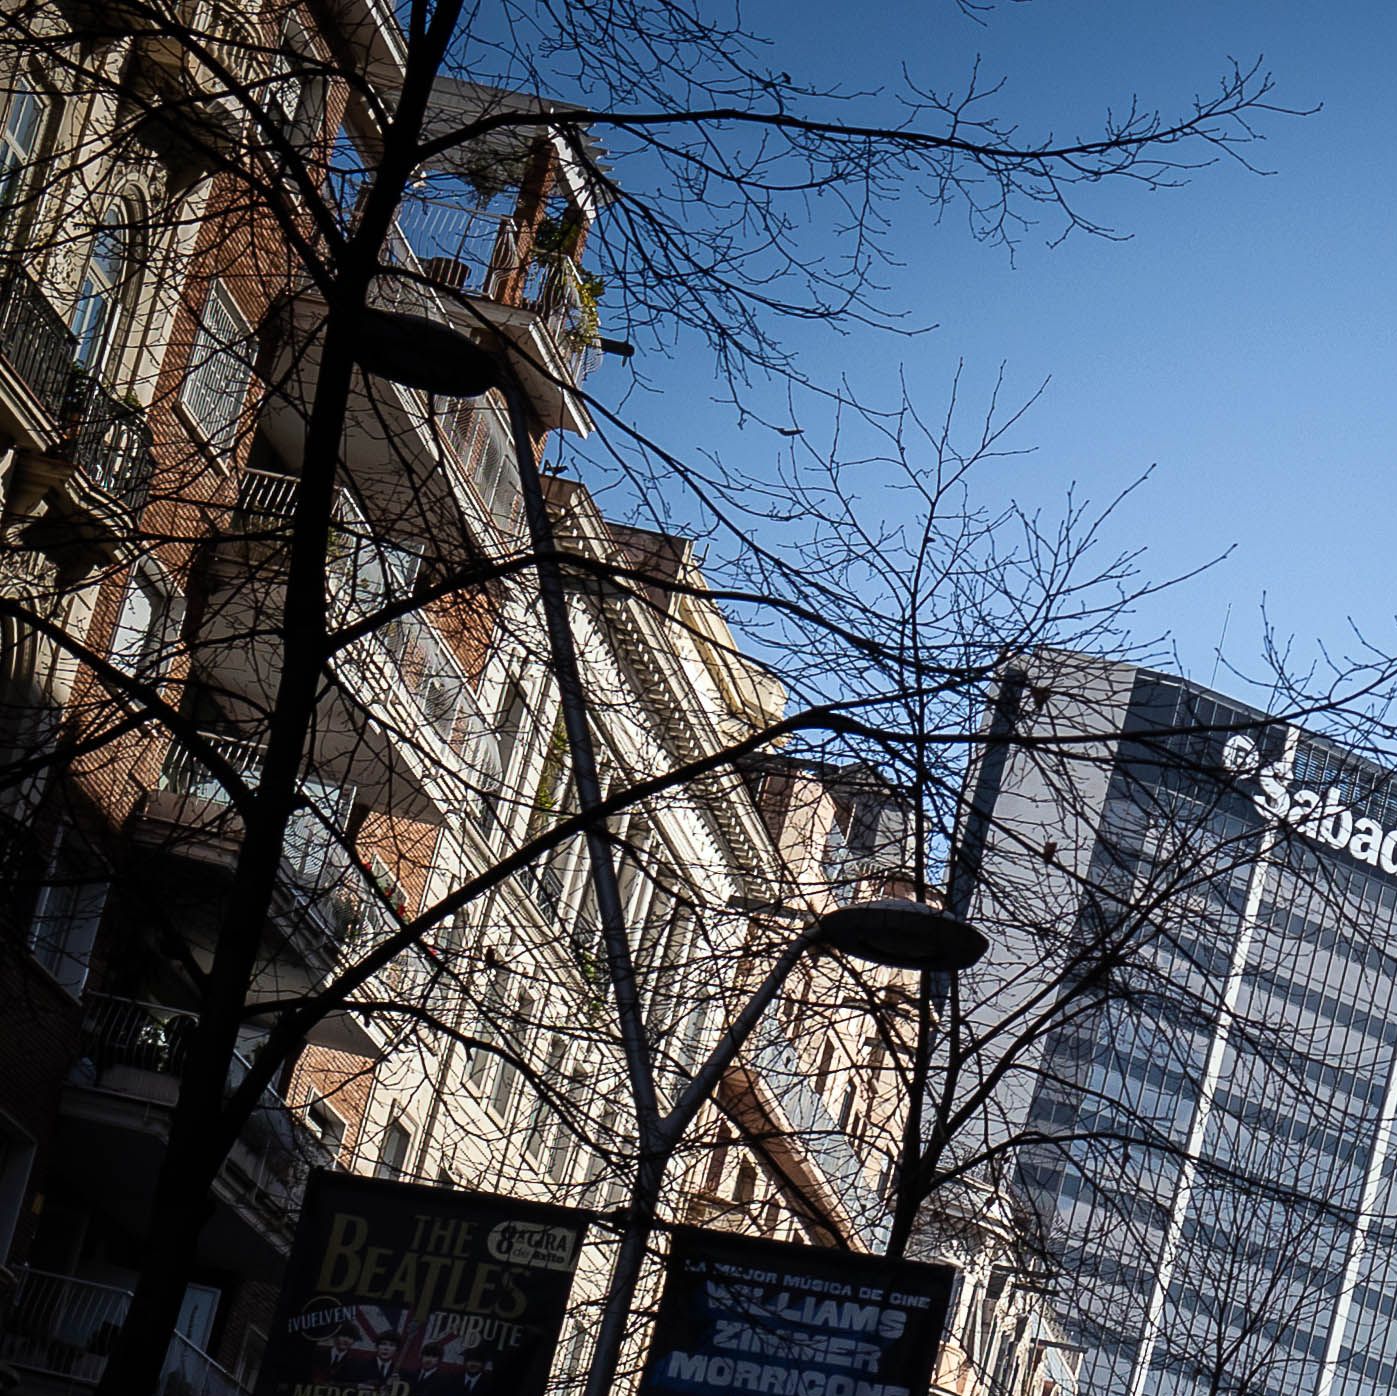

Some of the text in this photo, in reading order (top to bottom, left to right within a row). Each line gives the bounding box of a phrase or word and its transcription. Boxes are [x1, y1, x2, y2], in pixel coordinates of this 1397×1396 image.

[409, 1214, 479, 1258] THE
[314, 1212, 531, 1325] BEATLES
[288, 1304, 356, 1334] ¡VUELVEN!
[858, 1286, 885, 1300] DE
[889, 1293, 932, 1310] CINE
[431, 1311, 525, 1351] TRIBUTE
[712, 1319, 883, 1374] ZIMMER
